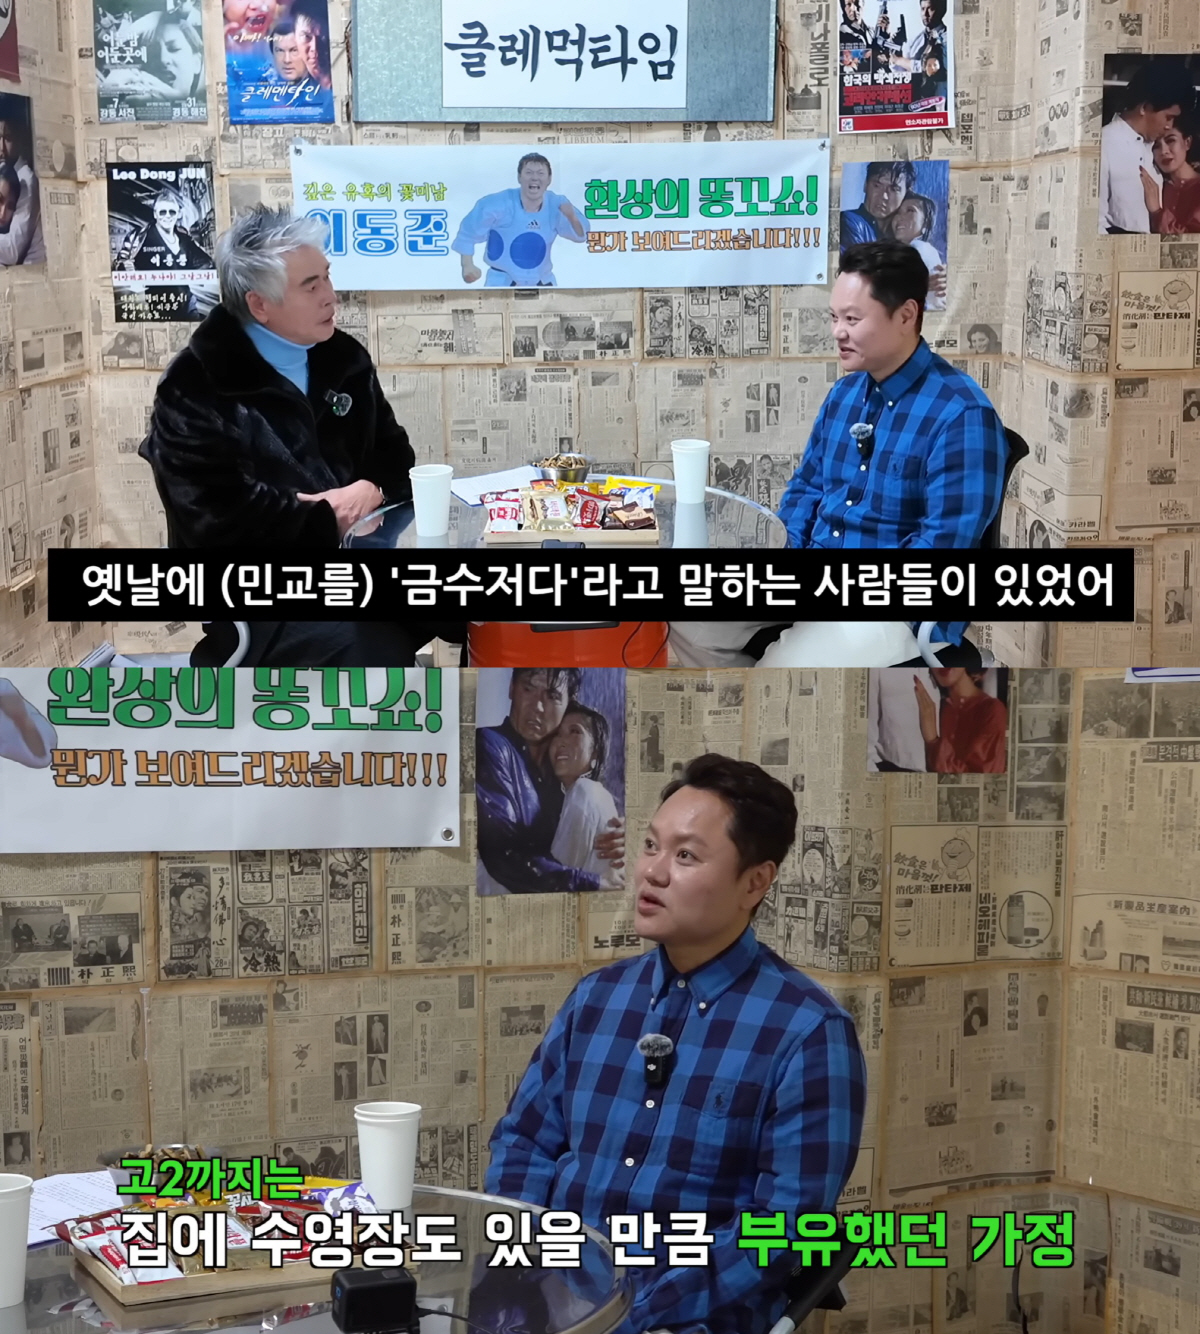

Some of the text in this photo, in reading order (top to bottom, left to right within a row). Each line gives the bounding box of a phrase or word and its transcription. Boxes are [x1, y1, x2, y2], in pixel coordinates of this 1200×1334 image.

[444, 20, 678, 85] 클레먹타임
[843, 73, 871, 86] 한국의
[240, 78, 320, 107] 클레멘타인
[140, 168, 176, 182] Dong
[179, 167, 207, 180] JUN
[303, 183, 447, 202] 깊은 유혹의 꽃미남
[584, 175, 818, 220] 환상의 똥꼬쇼!
[586, 231, 628, 253] 뭔가
[47, 667, 235, 730] 환상의
[50, 749, 448, 787] 뭔가 보여드리겠습니다!!!
[930, 883, 972, 895] 판타제
